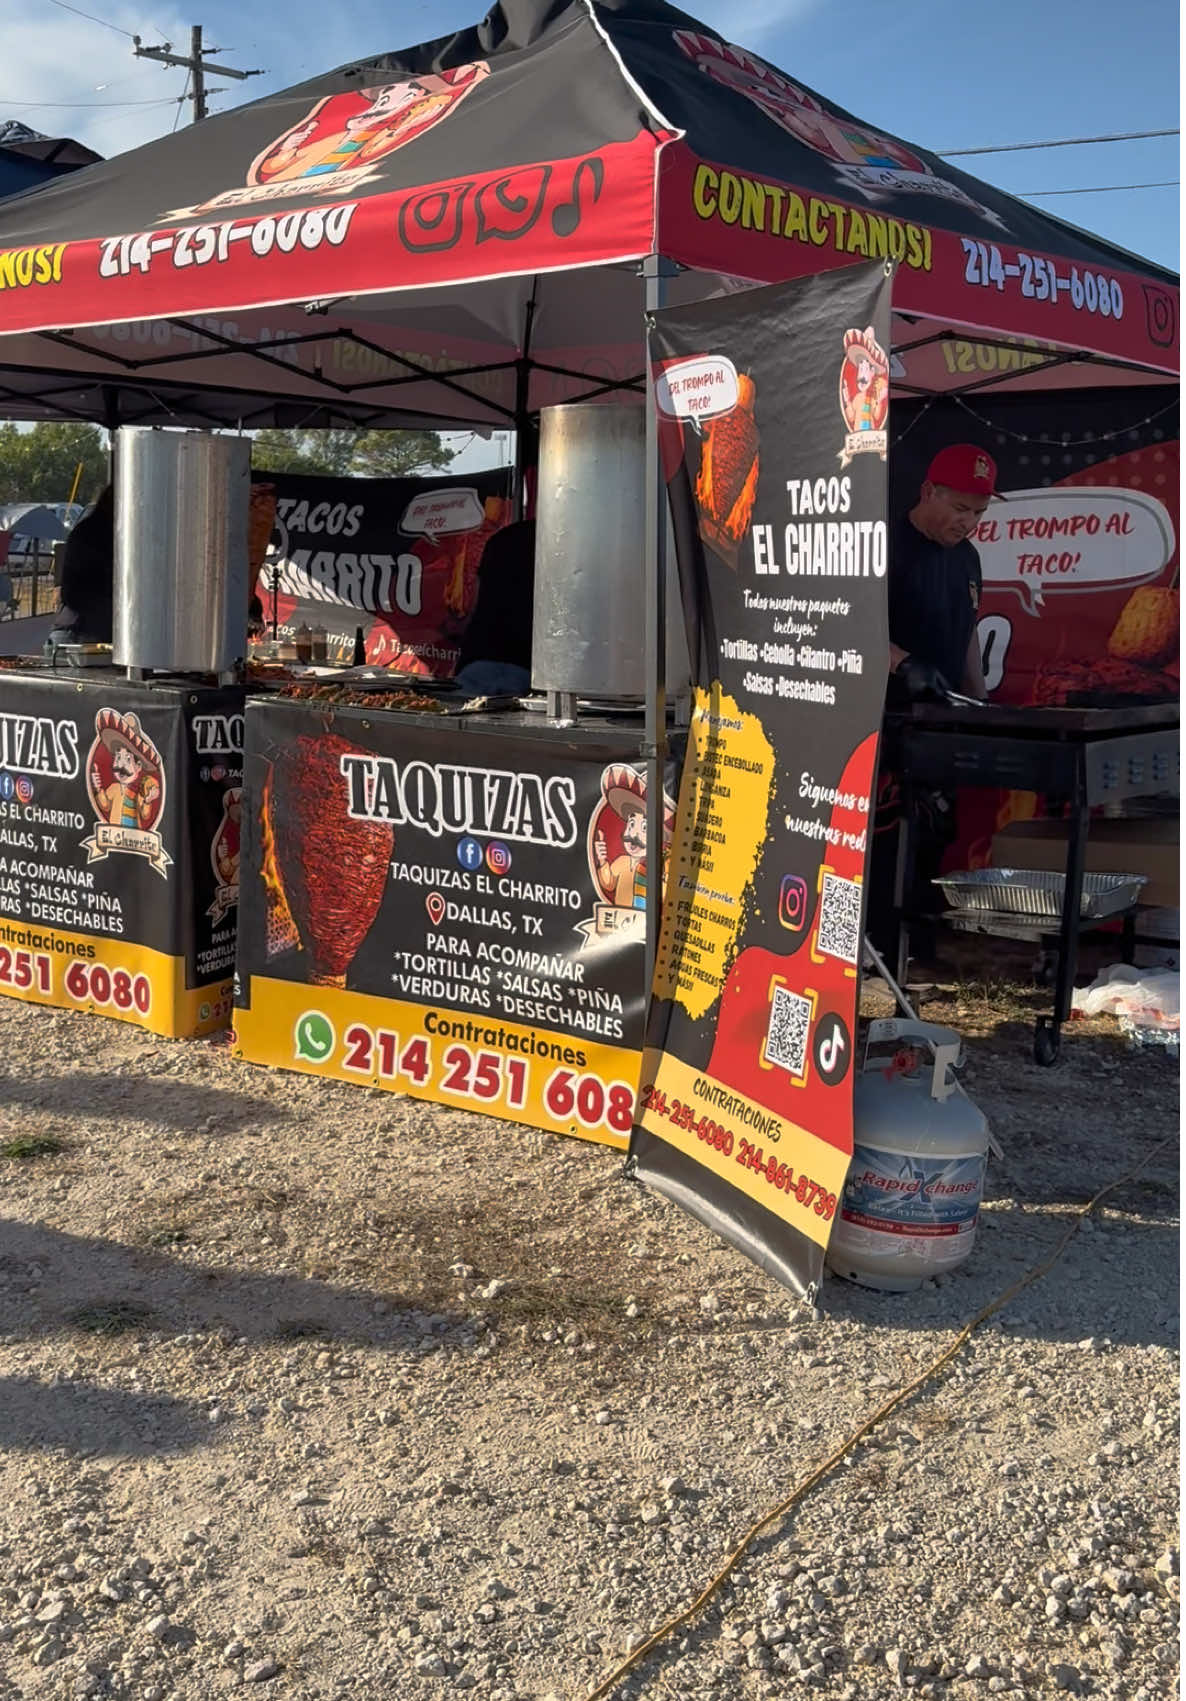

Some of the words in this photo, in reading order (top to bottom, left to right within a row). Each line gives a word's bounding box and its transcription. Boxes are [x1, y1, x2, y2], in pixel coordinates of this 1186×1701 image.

[693, 164, 933, 271] CONTACTANOS!
[959, 237, 1125, 320] 214-251-6080
[681, 376, 715, 392] TROMPO
[715, 371, 725, 385] AL
[687, 397, 712, 412] TACO!
[786, 476, 852, 516] TACOS
[276, 498, 365, 536] TACOS
[1006, 514, 1100, 541] TROMPO
[1105, 511, 1136, 536] AL
[752, 524, 780, 575] EL
[784, 520, 888, 578] CHARRITO
[1016, 551, 1083, 576] TACO!
[743, 589, 767, 611] Todos
[768, 595, 808, 614] nuestros
[808, 597, 851, 620] paquetes
[773, 616, 818, 642] incluyen:
[340, 754, 579, 848] TAQUIZAS
[798, 771, 858, 812] Siguenos
[9, 803, 21, 820] EL
[24, 805, 85, 831] CHARRITO
[785, 815, 842, 847] nuestras
[41, 835, 58, 853] TX
[10, 858, 94, 889] ACOMPAÑAR
[390, 861, 471, 891] TAQUIZAS
[475, 875, 494, 895] EL
[498, 878, 582, 910] CHARRITO
[446, 901, 517, 936] DALLAS,
[522, 914, 544, 937] TX
[426, 933, 471, 957] PARA
[477, 941, 585, 983] ACOMPAÑAR
[673, 929, 716, 954] QUESADILLAS
[66, 959, 152, 1017] 6080
[692, 967, 721, 988] FRESCAS
[423, 1011, 588, 1067] Contrataciones
[343, 1022, 431, 1086] 214
[438, 1043, 531, 1110] 251
[692, 1077, 783, 1144] CONTRATACIONES
[640, 1084, 735, 1157] 214-251-6080
[735, 1137, 837, 1221] 214-861-8739
[858, 1169, 921, 1193] Rapid
